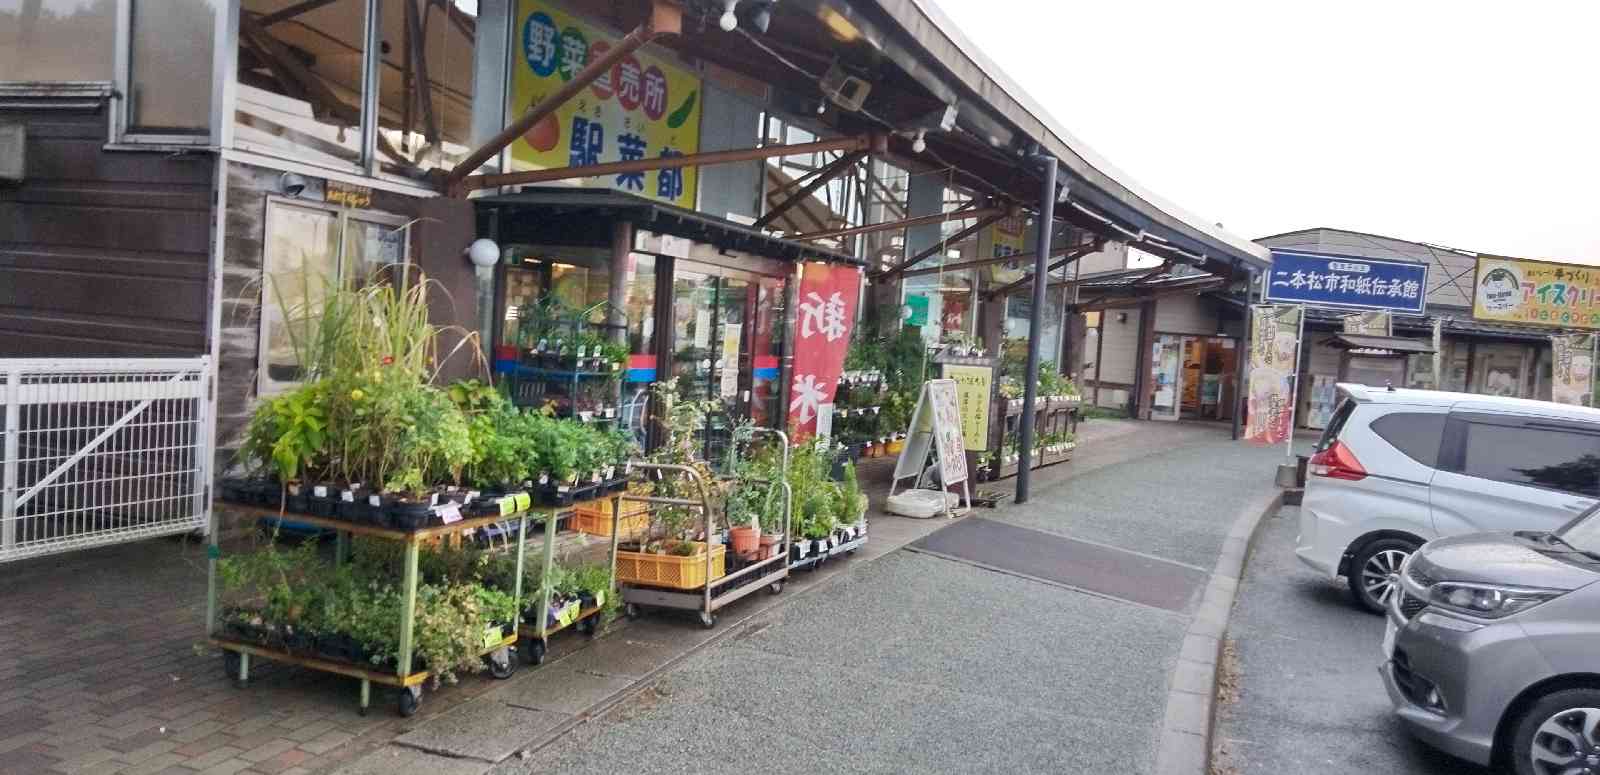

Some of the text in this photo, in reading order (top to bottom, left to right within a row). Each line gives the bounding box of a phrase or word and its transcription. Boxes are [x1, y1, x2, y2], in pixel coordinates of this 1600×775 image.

[570, 116, 683, 200] 駅菜都
[1272, 270, 1419, 298] 二本松市和紙伝承館
